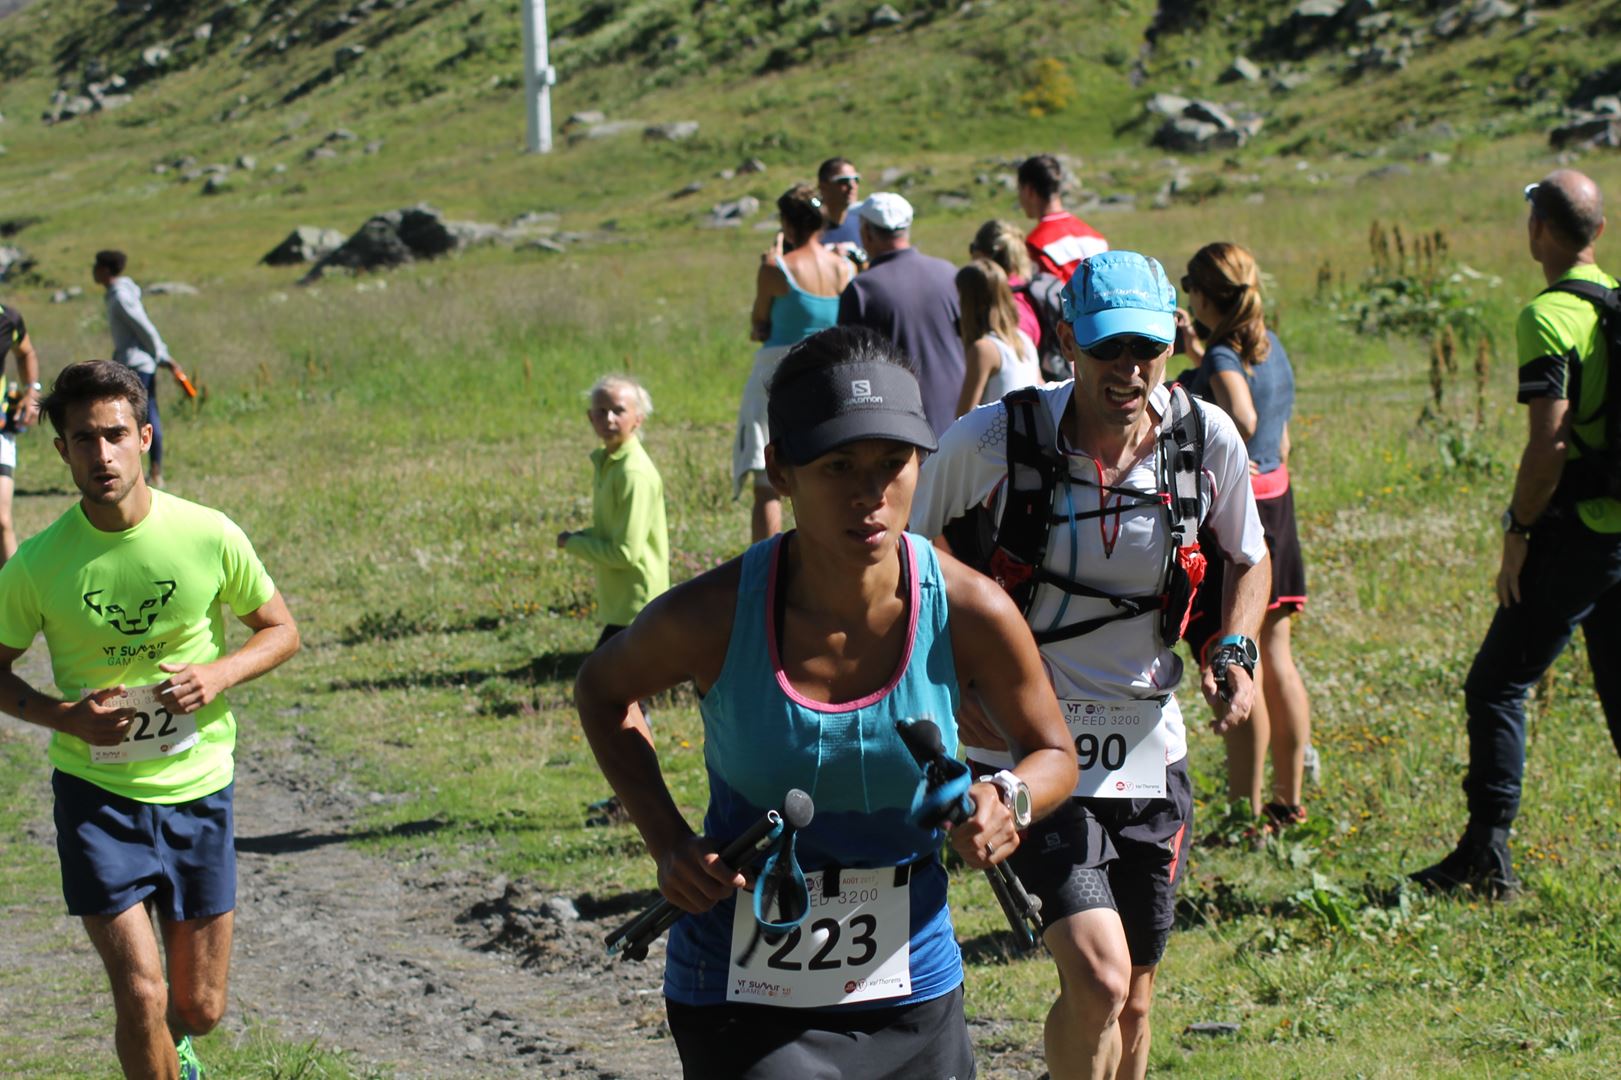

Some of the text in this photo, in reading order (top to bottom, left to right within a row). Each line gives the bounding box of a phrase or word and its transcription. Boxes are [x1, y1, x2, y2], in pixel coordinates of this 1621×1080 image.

[1067, 704, 1081, 714] VT
[1064, 715, 1140, 725] SPEED 3200
[1075, 733, 1127, 771] 90
[838, 888, 878, 904] 3200
[768, 914, 877, 971] 223
